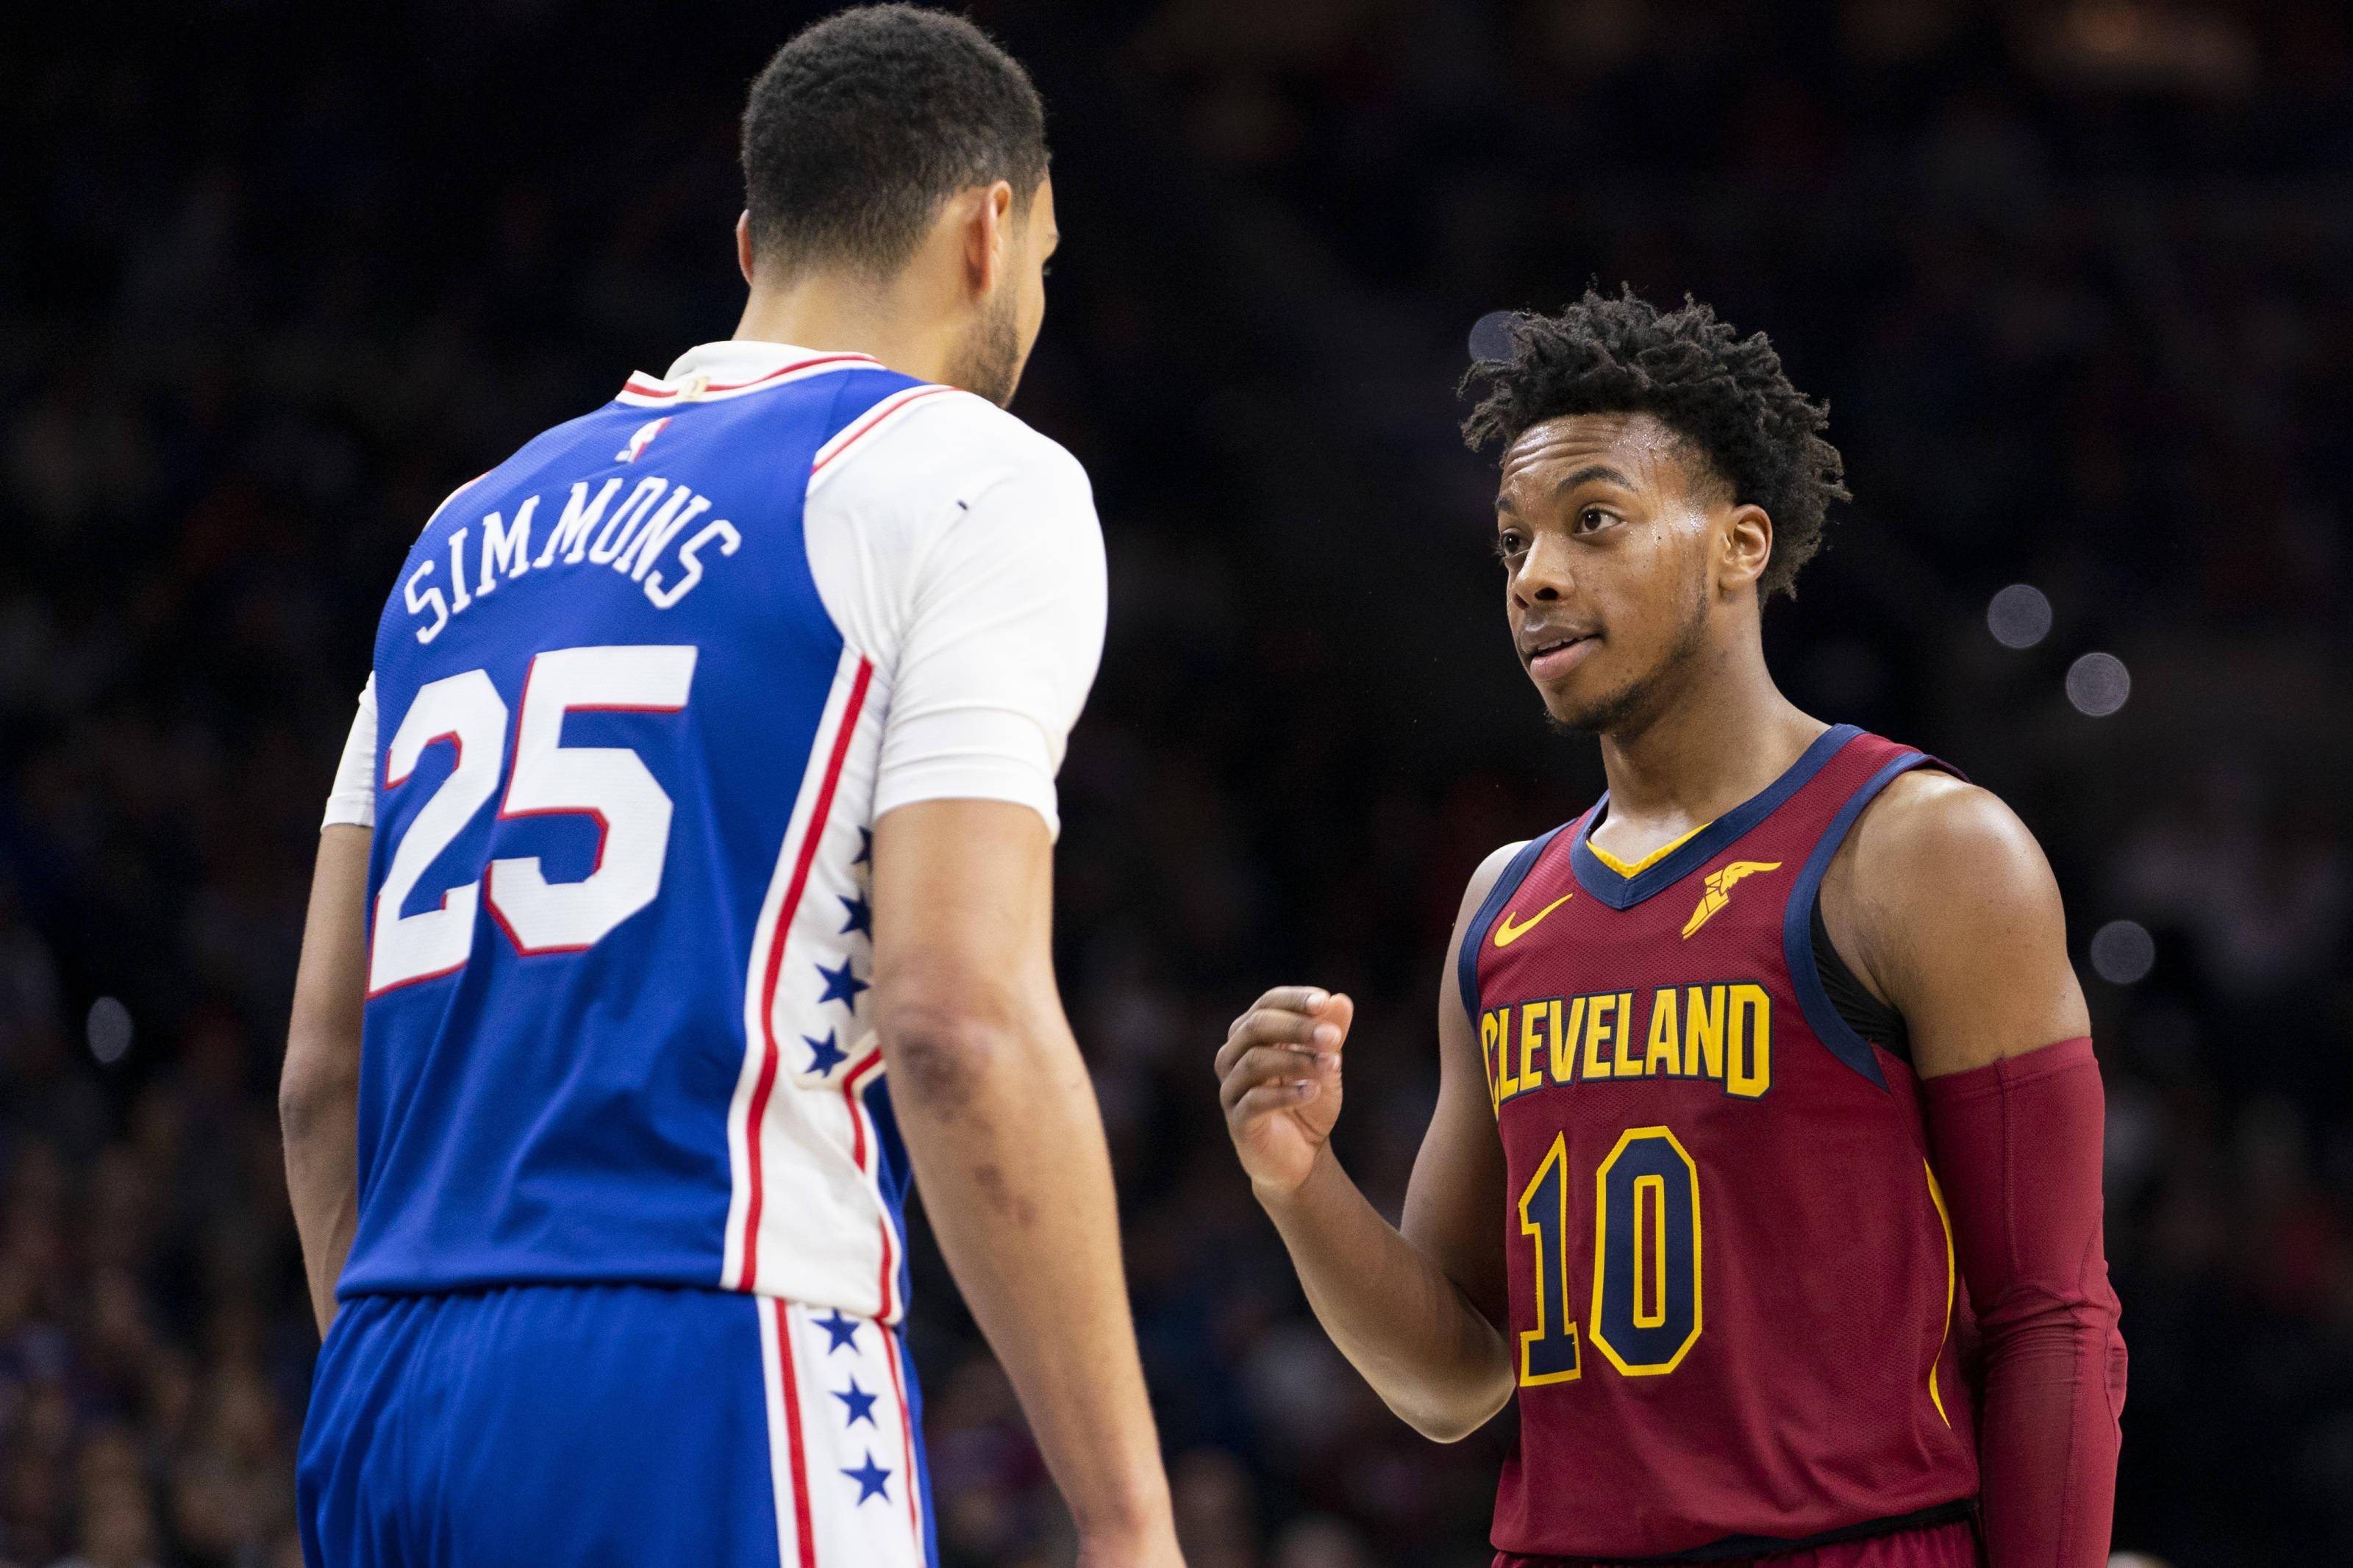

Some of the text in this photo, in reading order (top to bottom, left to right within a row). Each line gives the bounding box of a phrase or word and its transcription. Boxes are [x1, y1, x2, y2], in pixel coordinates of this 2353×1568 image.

[404, 476, 741, 645] SIMMONS
[365, 645, 699, 1000] 25
[1480, 980, 1774, 1122] CLEVELAND
[1518, 1125, 1702, 1387] 10
